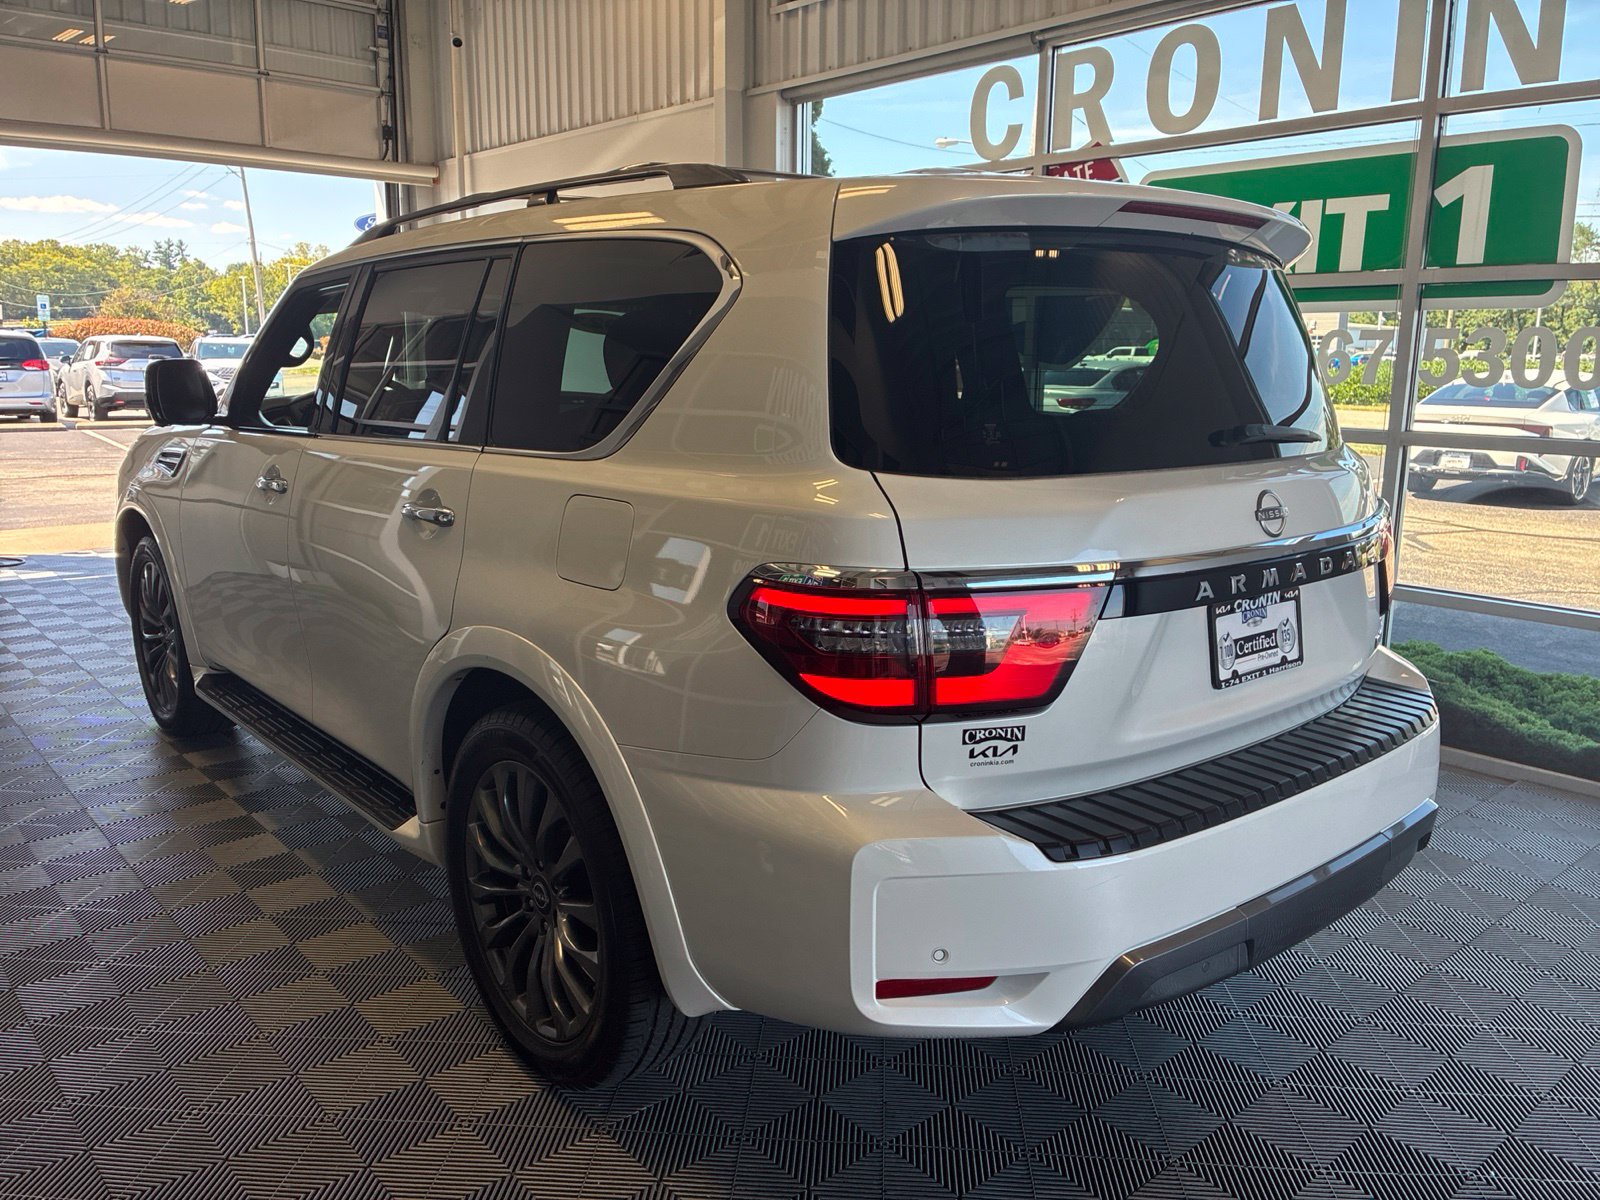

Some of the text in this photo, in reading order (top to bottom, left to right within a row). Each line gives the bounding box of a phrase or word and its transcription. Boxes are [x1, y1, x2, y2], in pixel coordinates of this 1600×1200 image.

[970, 0, 1566, 161] CRONIN
[1434, 165, 1494, 265] 1
[1418, 326, 1600, 391] 5300
[1195, 551, 1357, 601] ARMADA
[1236, 632, 1276, 655] Certified
[1257, 650, 1279, 661] Pre-Owned
[1221, 678, 1240, 689] I-74
[1241, 671, 1261, 683] EXIT
[1269, 660, 1302, 674] Harrison
[964, 726, 1024, 744] CRONIN
[970, 759, 1015, 767] croninkia.com
